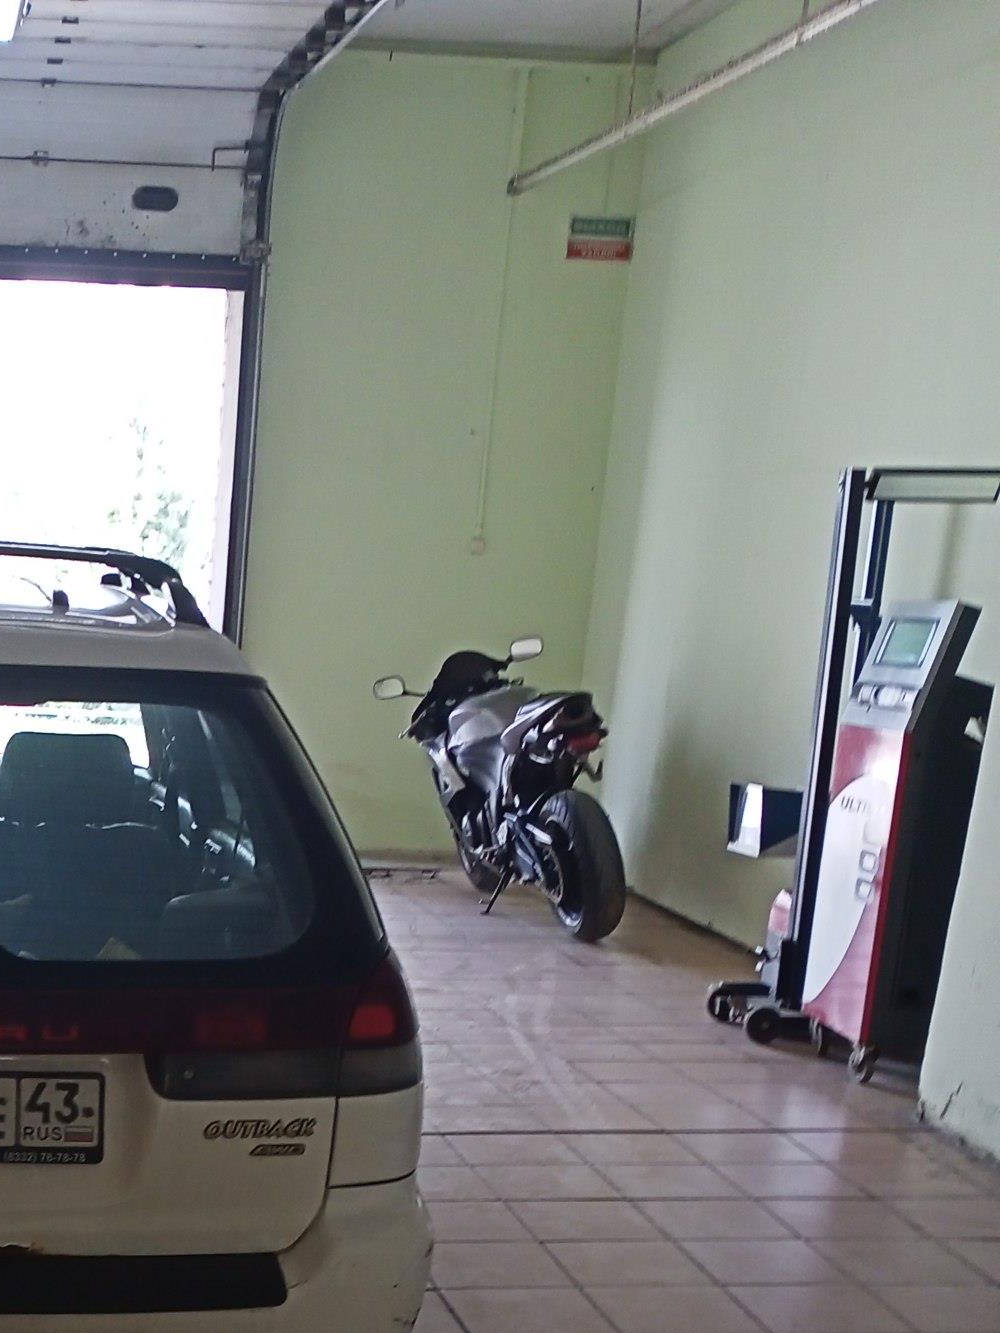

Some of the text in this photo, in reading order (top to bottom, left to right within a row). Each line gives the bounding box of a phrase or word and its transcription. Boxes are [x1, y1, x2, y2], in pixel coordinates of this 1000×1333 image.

[24, 1081, 80, 1125] 43
[22, 1126, 63, 1142] RUS
[202, 1117, 317, 1141] OUTBACK
